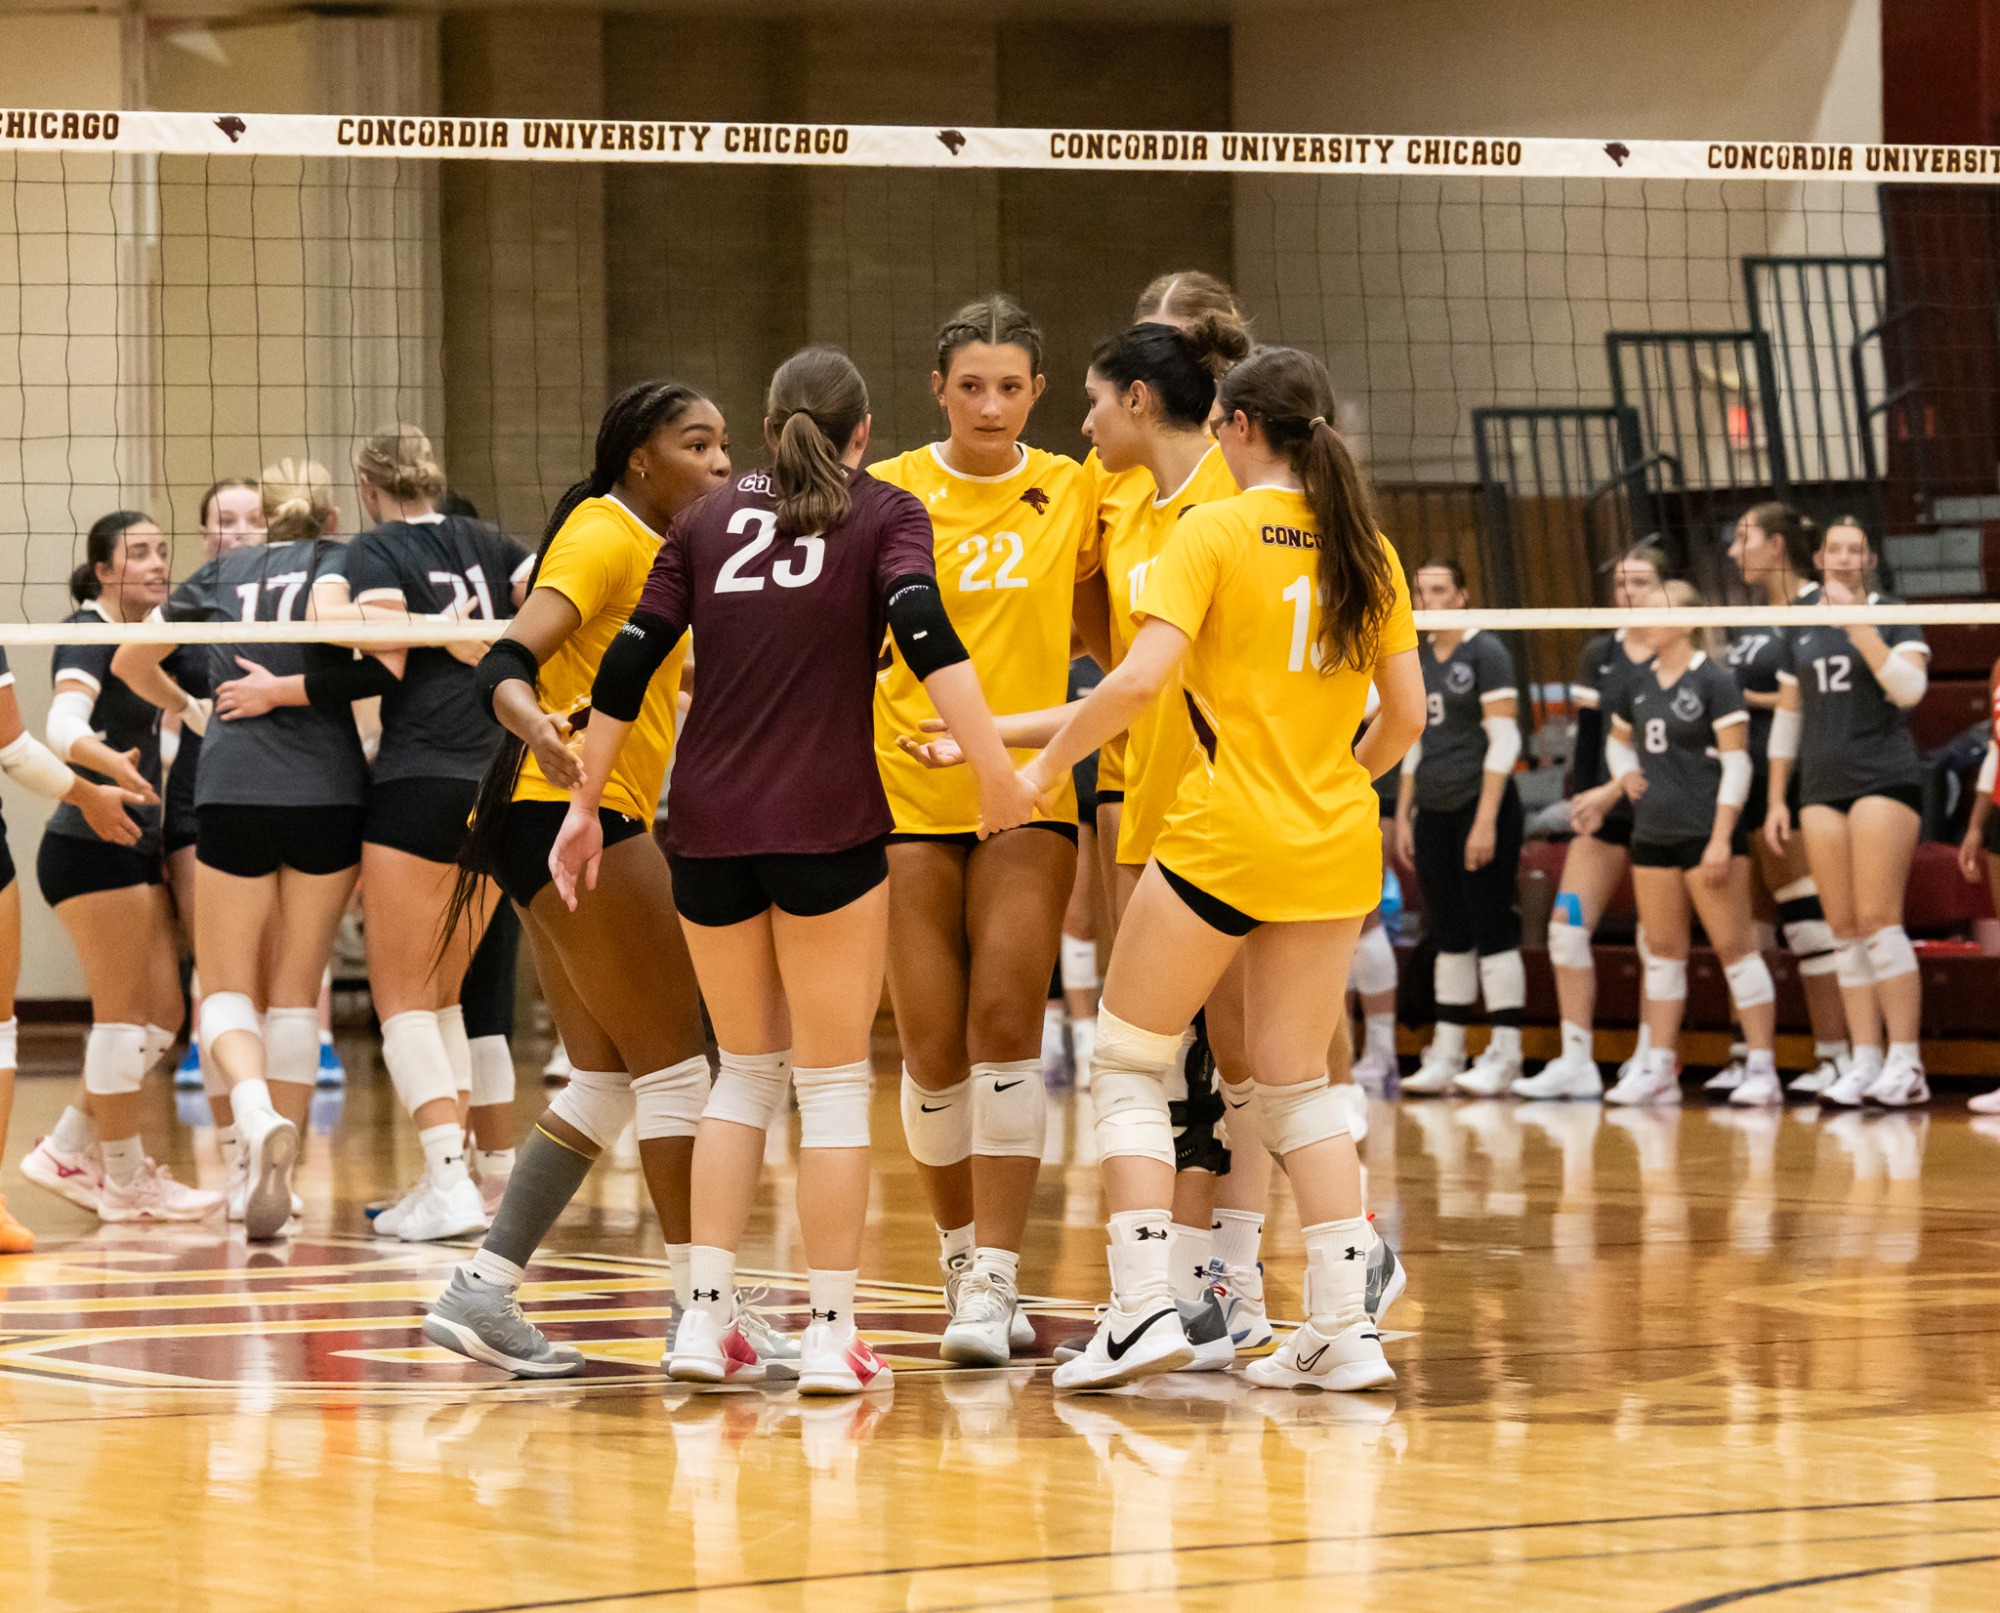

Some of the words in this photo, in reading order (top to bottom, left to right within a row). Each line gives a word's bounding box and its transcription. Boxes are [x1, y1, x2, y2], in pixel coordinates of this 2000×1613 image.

[0, 111, 119, 141] HICAGO
[337, 118, 509, 147] CONCORDIA
[523, 121, 711, 152] UNIVERSITY
[724, 126, 849, 154] CHICAGO
[1050, 132, 1208, 160] CONCORDIA
[1221, 135, 1395, 164] UNIVERSITY
[1406, 139, 1522, 166] CHICAGO
[1707, 145, 1853, 171] CONCORDIA
[714, 507, 826, 594] 23
[957, 531, 1029, 592] 22
[235, 571, 308, 622] 17
[1812, 655, 1852, 693] 12
[1645, 717, 1668, 754] 8
